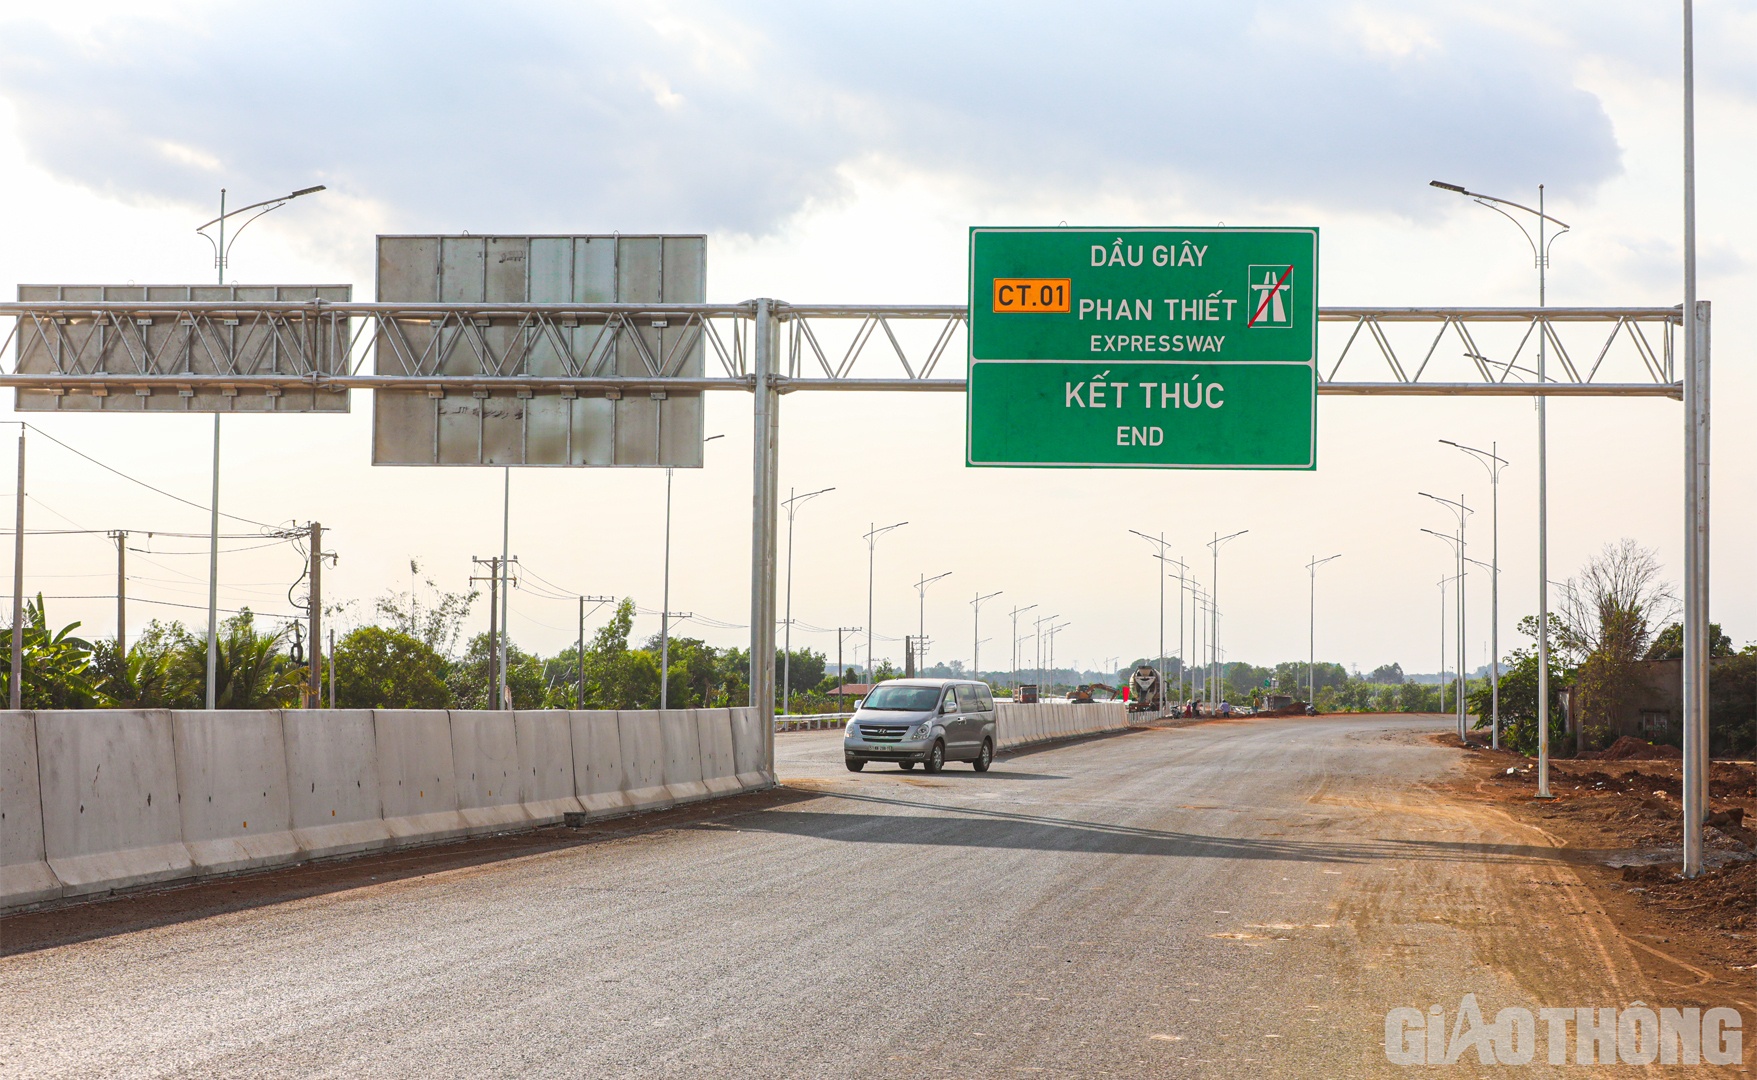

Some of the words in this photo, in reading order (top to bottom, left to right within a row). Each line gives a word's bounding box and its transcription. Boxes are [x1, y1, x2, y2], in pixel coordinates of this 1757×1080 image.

[1090, 237, 1144, 267] DẦU
[1152, 239, 1209, 267] GIÂY
[998, 284, 1064, 307] CT.01
[1078, 298, 1153, 321] PHAN
[1164, 289, 1238, 321] THIẾT
[1090, 335, 1226, 353] EXPRESSWAY
[1065, 369, 1129, 408] KẾT
[1139, 373, 1225, 409] THÚC
[1116, 425, 1164, 446] END
